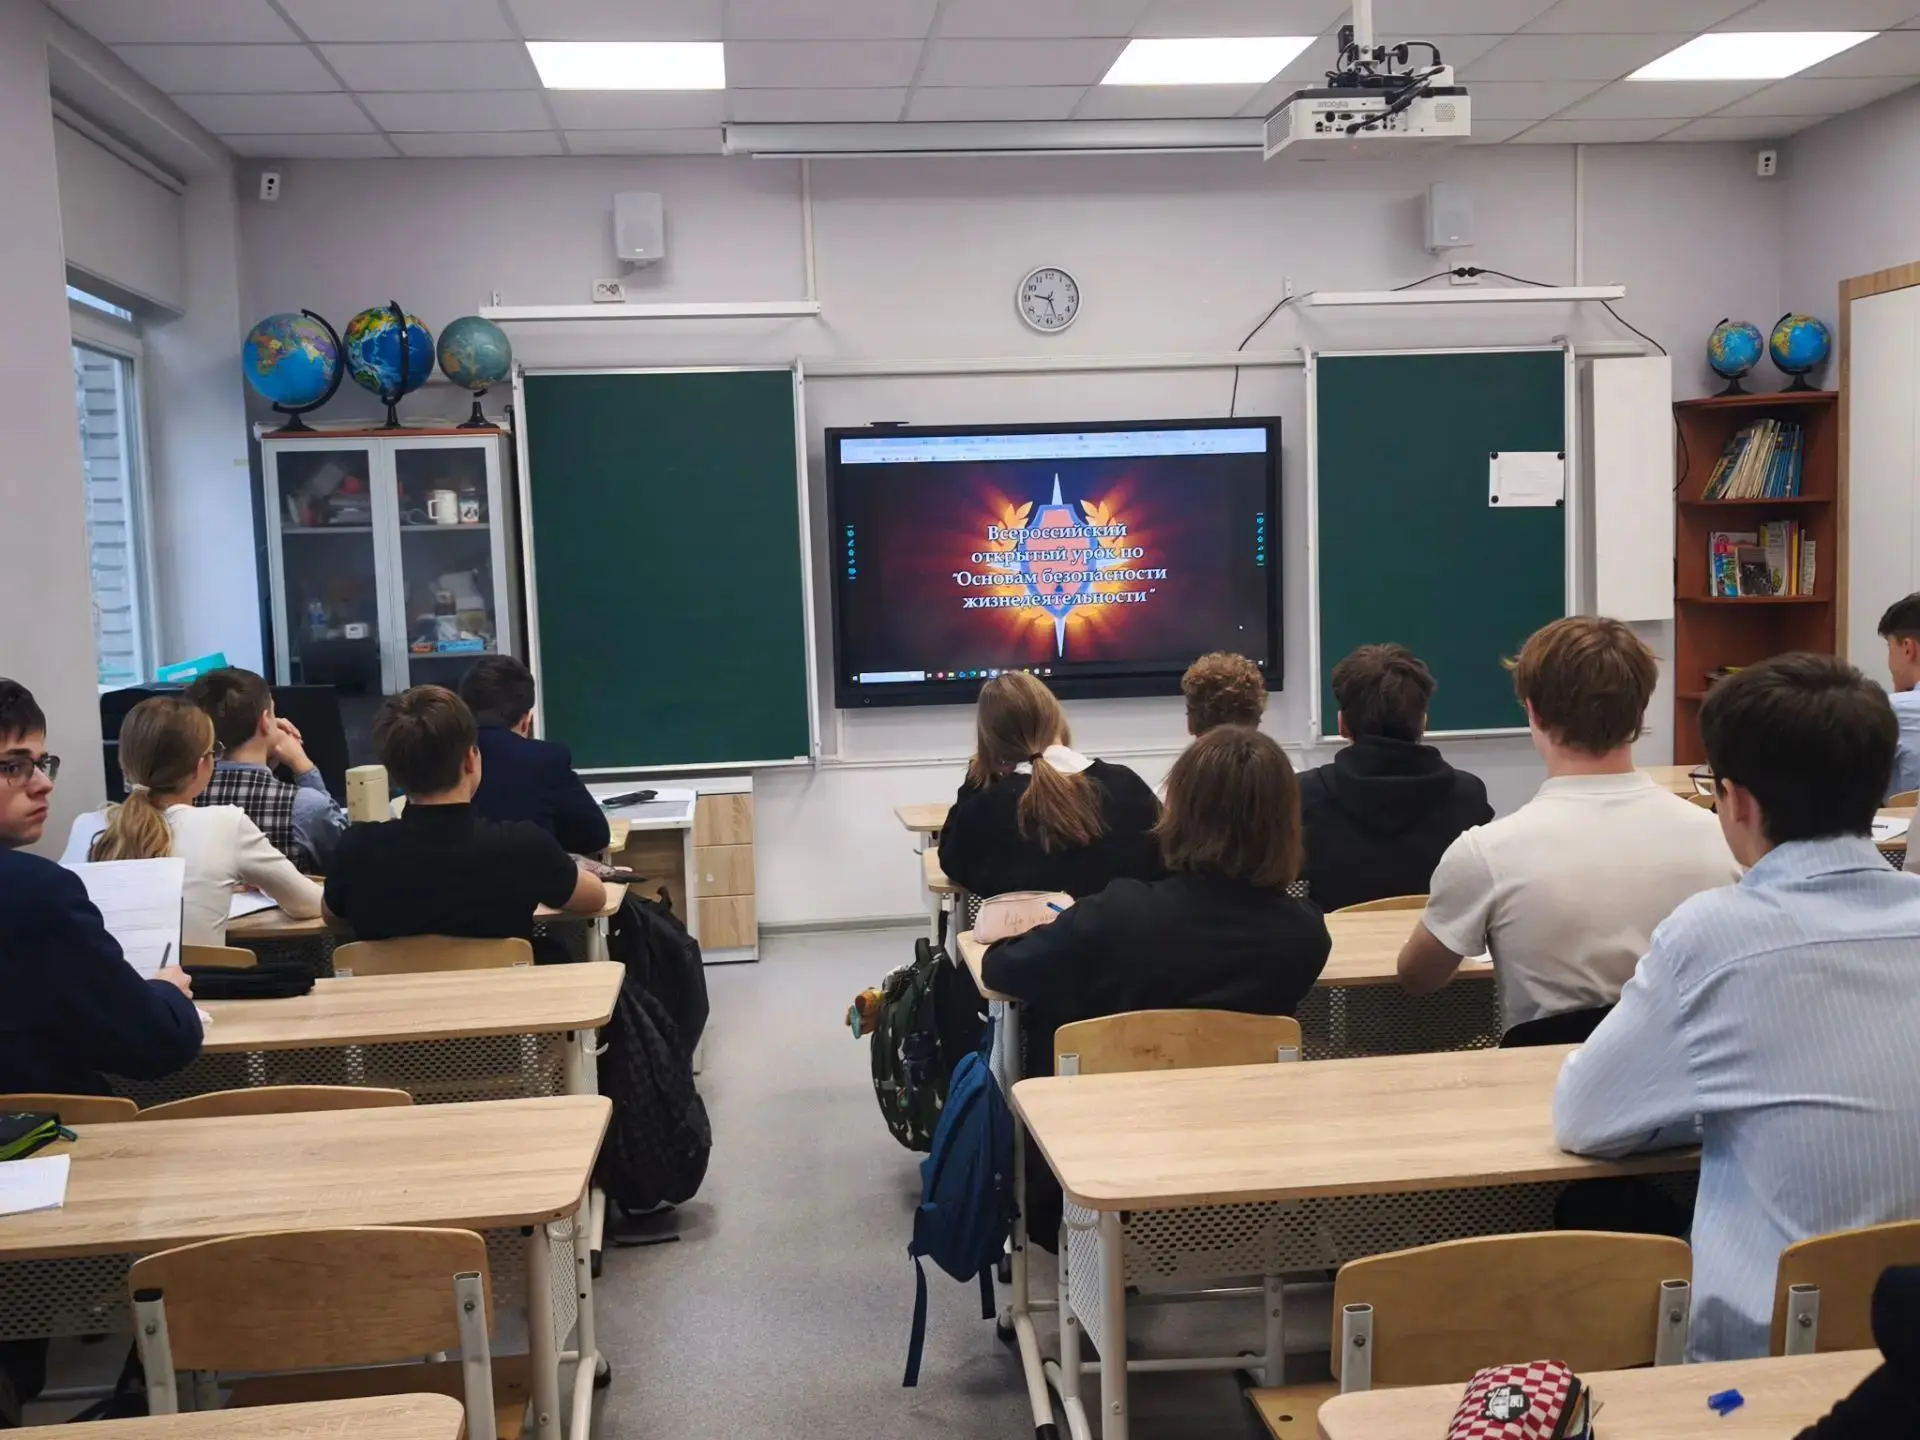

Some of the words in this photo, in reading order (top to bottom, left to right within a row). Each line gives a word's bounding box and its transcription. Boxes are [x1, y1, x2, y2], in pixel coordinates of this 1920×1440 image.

[987, 522, 1127, 544] Всероссийский
[971, 546, 1067, 567] открытый
[1071, 547, 1116, 565] урок
[1120, 547, 1144, 559] по
[1042, 568, 1168, 583] безопасности
